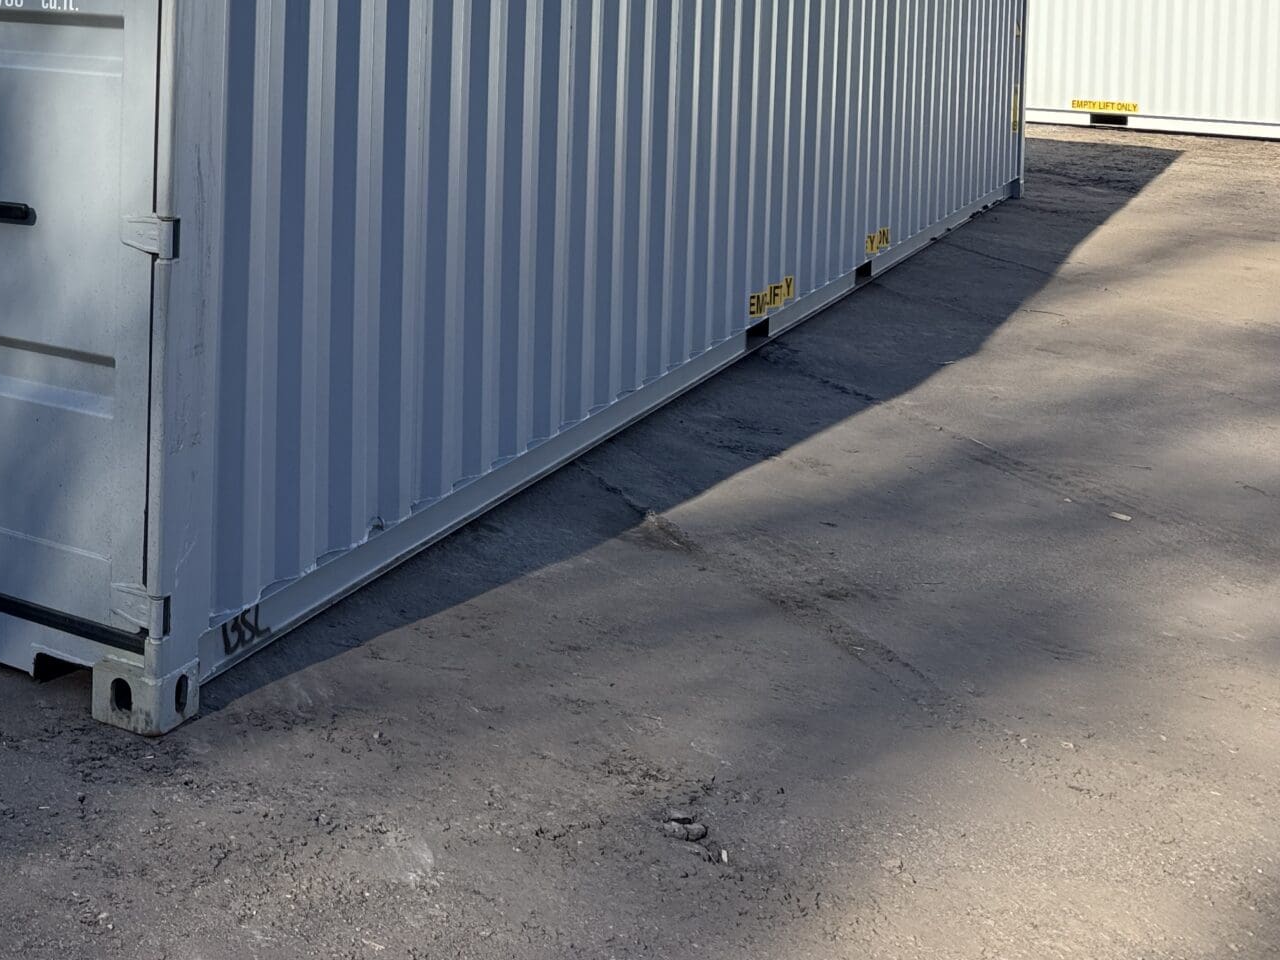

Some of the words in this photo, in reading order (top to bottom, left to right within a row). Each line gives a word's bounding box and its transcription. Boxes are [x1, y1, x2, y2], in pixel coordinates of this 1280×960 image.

[1071, 100, 1097, 109] EMPTY
[1098, 101, 1116, 110] LIFT
[1116, 102, 1138, 112] ONLY
